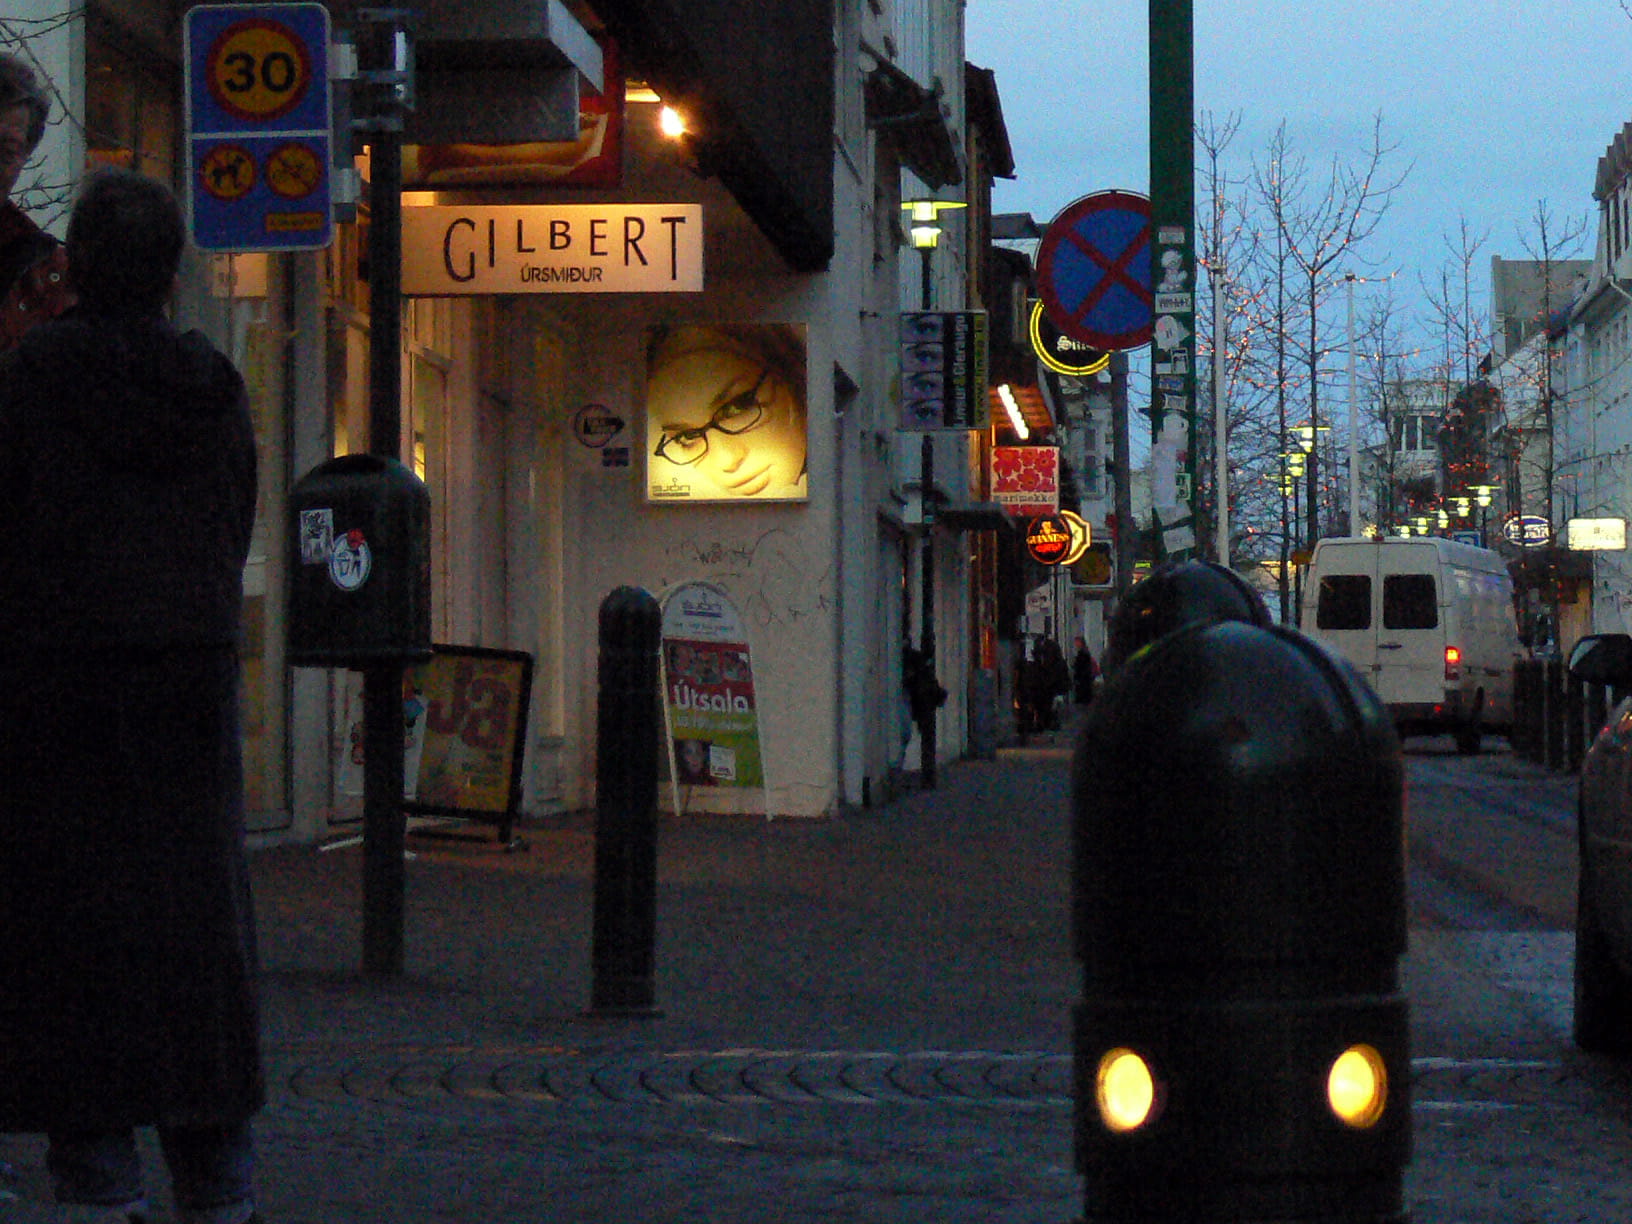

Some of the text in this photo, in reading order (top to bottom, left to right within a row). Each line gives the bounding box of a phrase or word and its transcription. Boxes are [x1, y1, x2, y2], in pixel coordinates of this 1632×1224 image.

[224, 52, 296, 93] 30
[443, 216, 687, 282] GILBERT
[674, 678, 749, 713] Útsala
